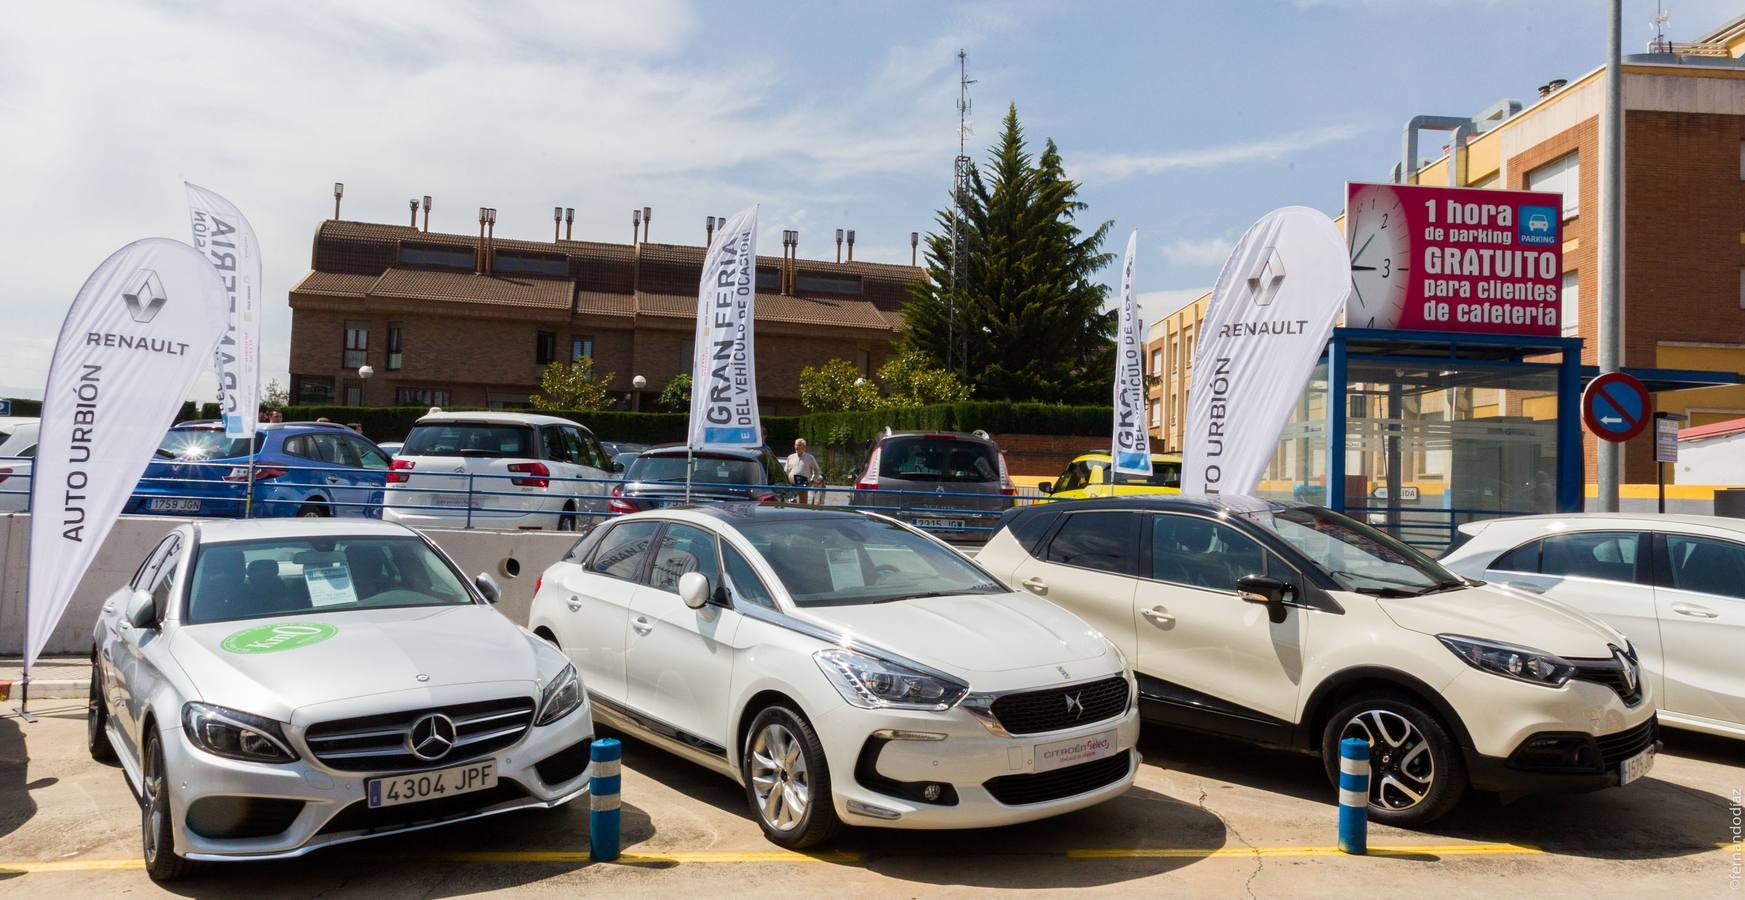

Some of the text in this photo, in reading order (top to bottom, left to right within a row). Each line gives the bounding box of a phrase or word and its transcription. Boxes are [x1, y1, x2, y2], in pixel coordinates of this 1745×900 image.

[1425, 199, 1512, 226] 1 hora
[1425, 227, 1512, 246] de parking
[1521, 234, 1555, 244] PARKING
[1382, 258, 1391, 279] 3
[1424, 247, 1557, 279] GRATUITO
[1423, 279, 1557, 302] para clientes
[1423, 300, 1557, 326] de cafetería
[706, 235, 739, 425] GRAN FERIA
[1218, 320, 1309, 339] RENAULT
[86, 331, 191, 357] RENAULT
[737, 394, 752, 426] DEL
[1206, 357, 1231, 458] URBIÓN
[62, 364, 103, 543] AUTO URBIÓN
[154, 499, 200, 510] 1759 JGN
[386, 764, 493, 802] 4304 JPF
